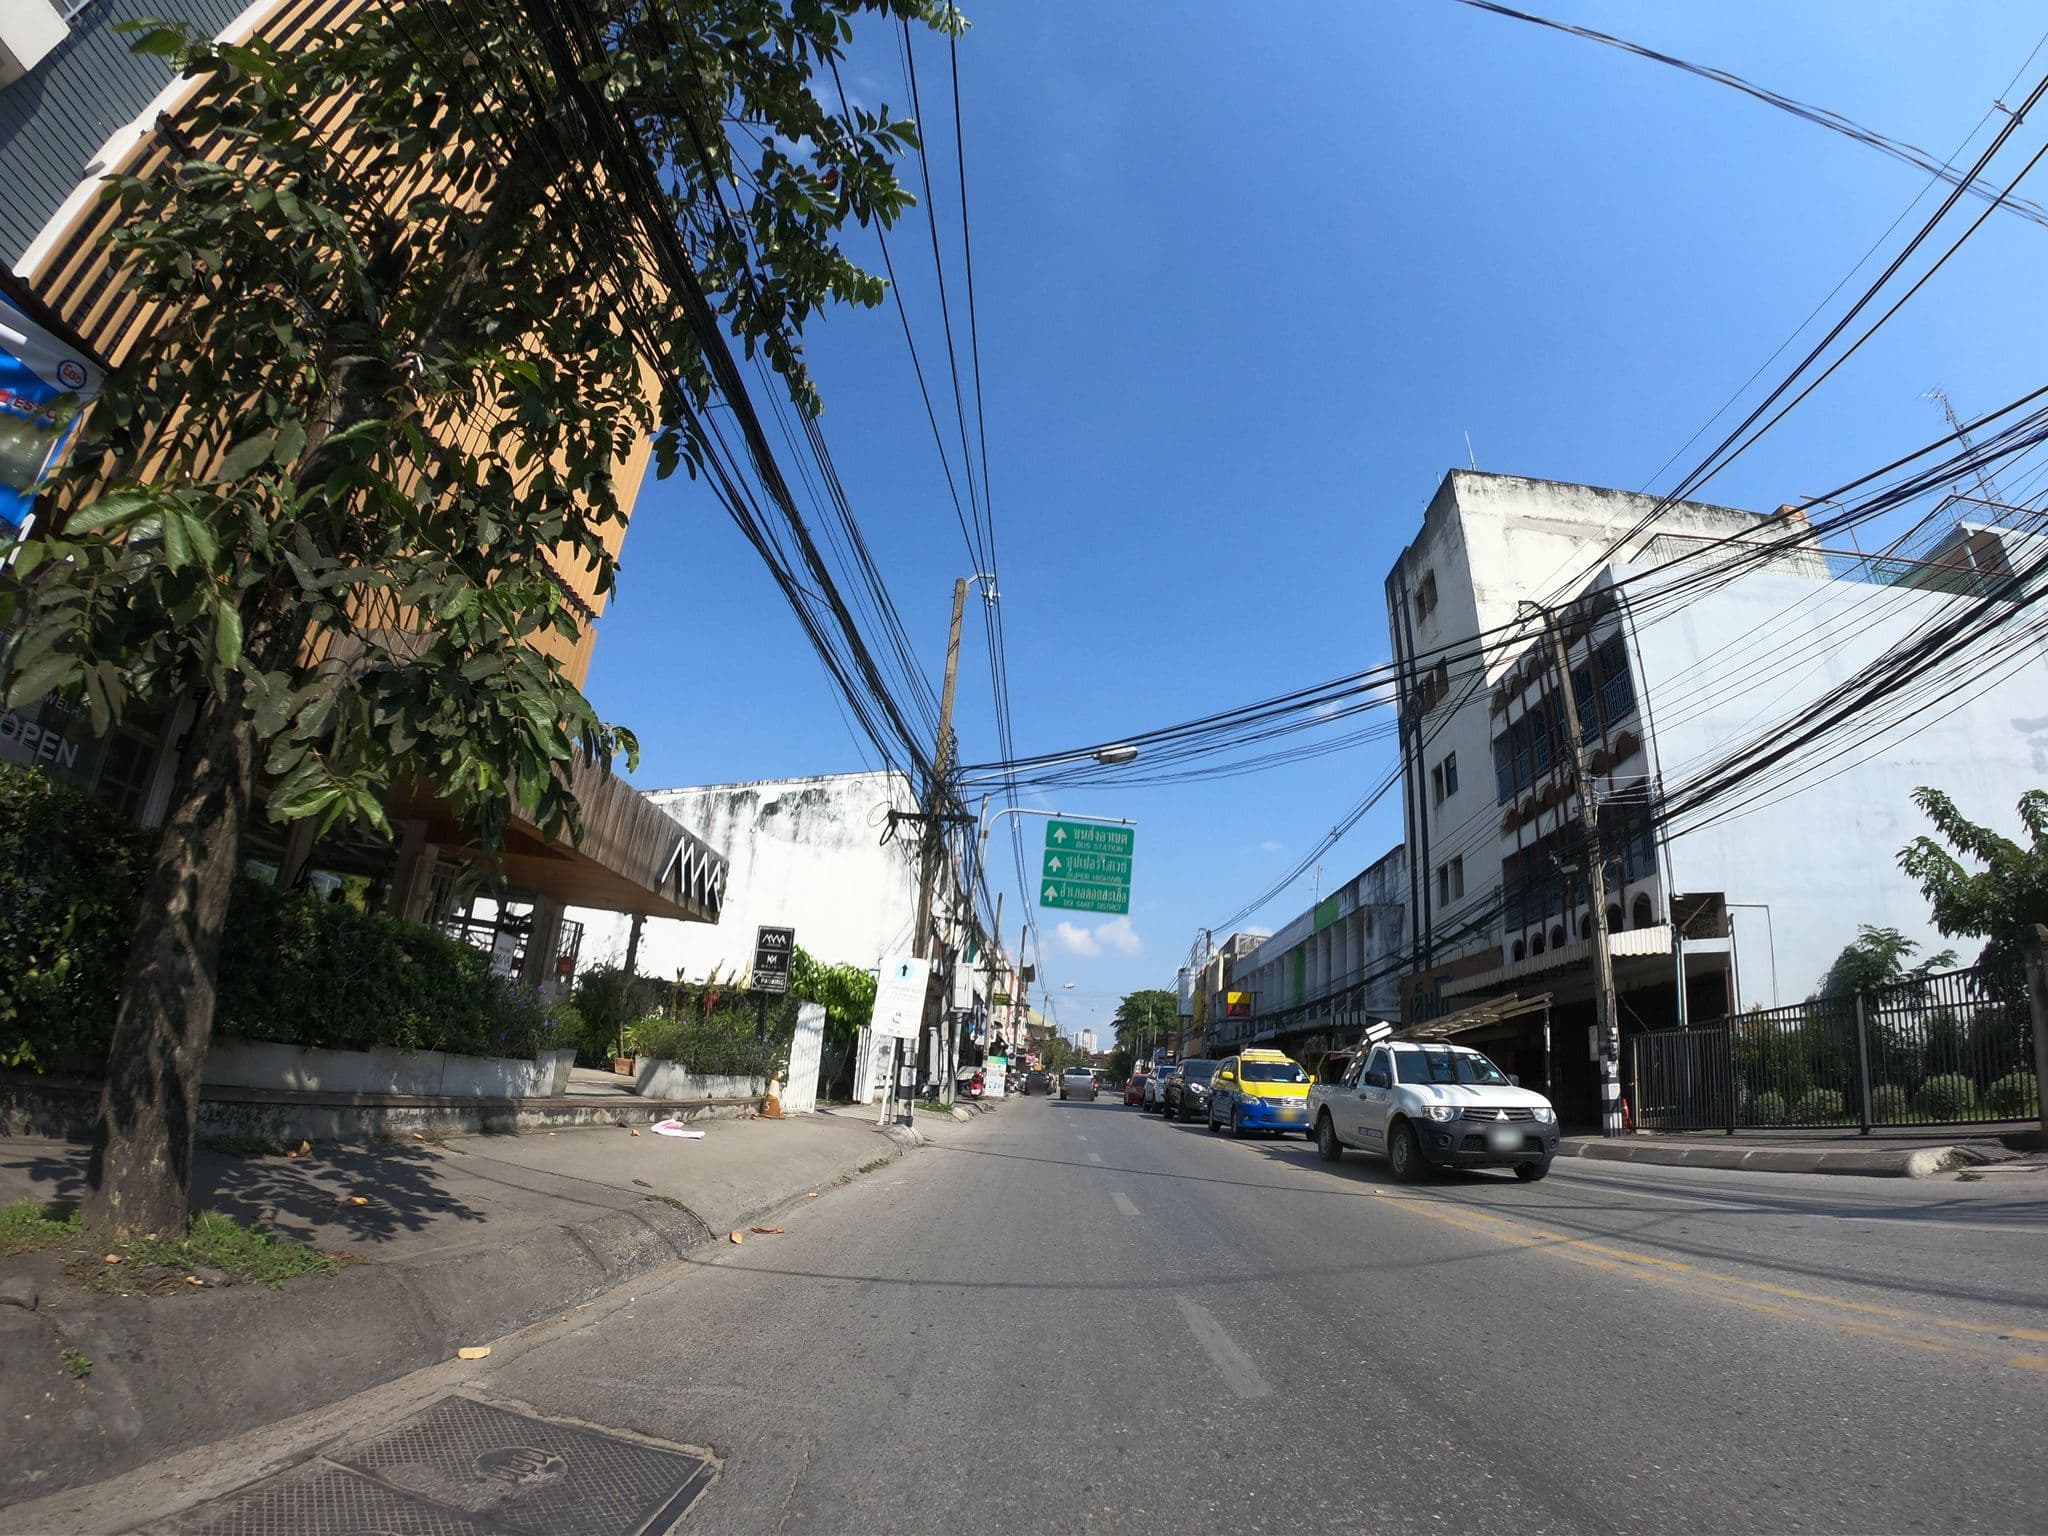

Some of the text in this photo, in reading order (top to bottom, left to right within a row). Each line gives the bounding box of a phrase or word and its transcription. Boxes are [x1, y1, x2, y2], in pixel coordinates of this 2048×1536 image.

[0, 713, 79, 769] OPEN
[1075, 841, 1124, 853] BUS STATION
[1096, 902, 1122, 912] DISTRICT
[764, 1101, 770, 1111] 5
